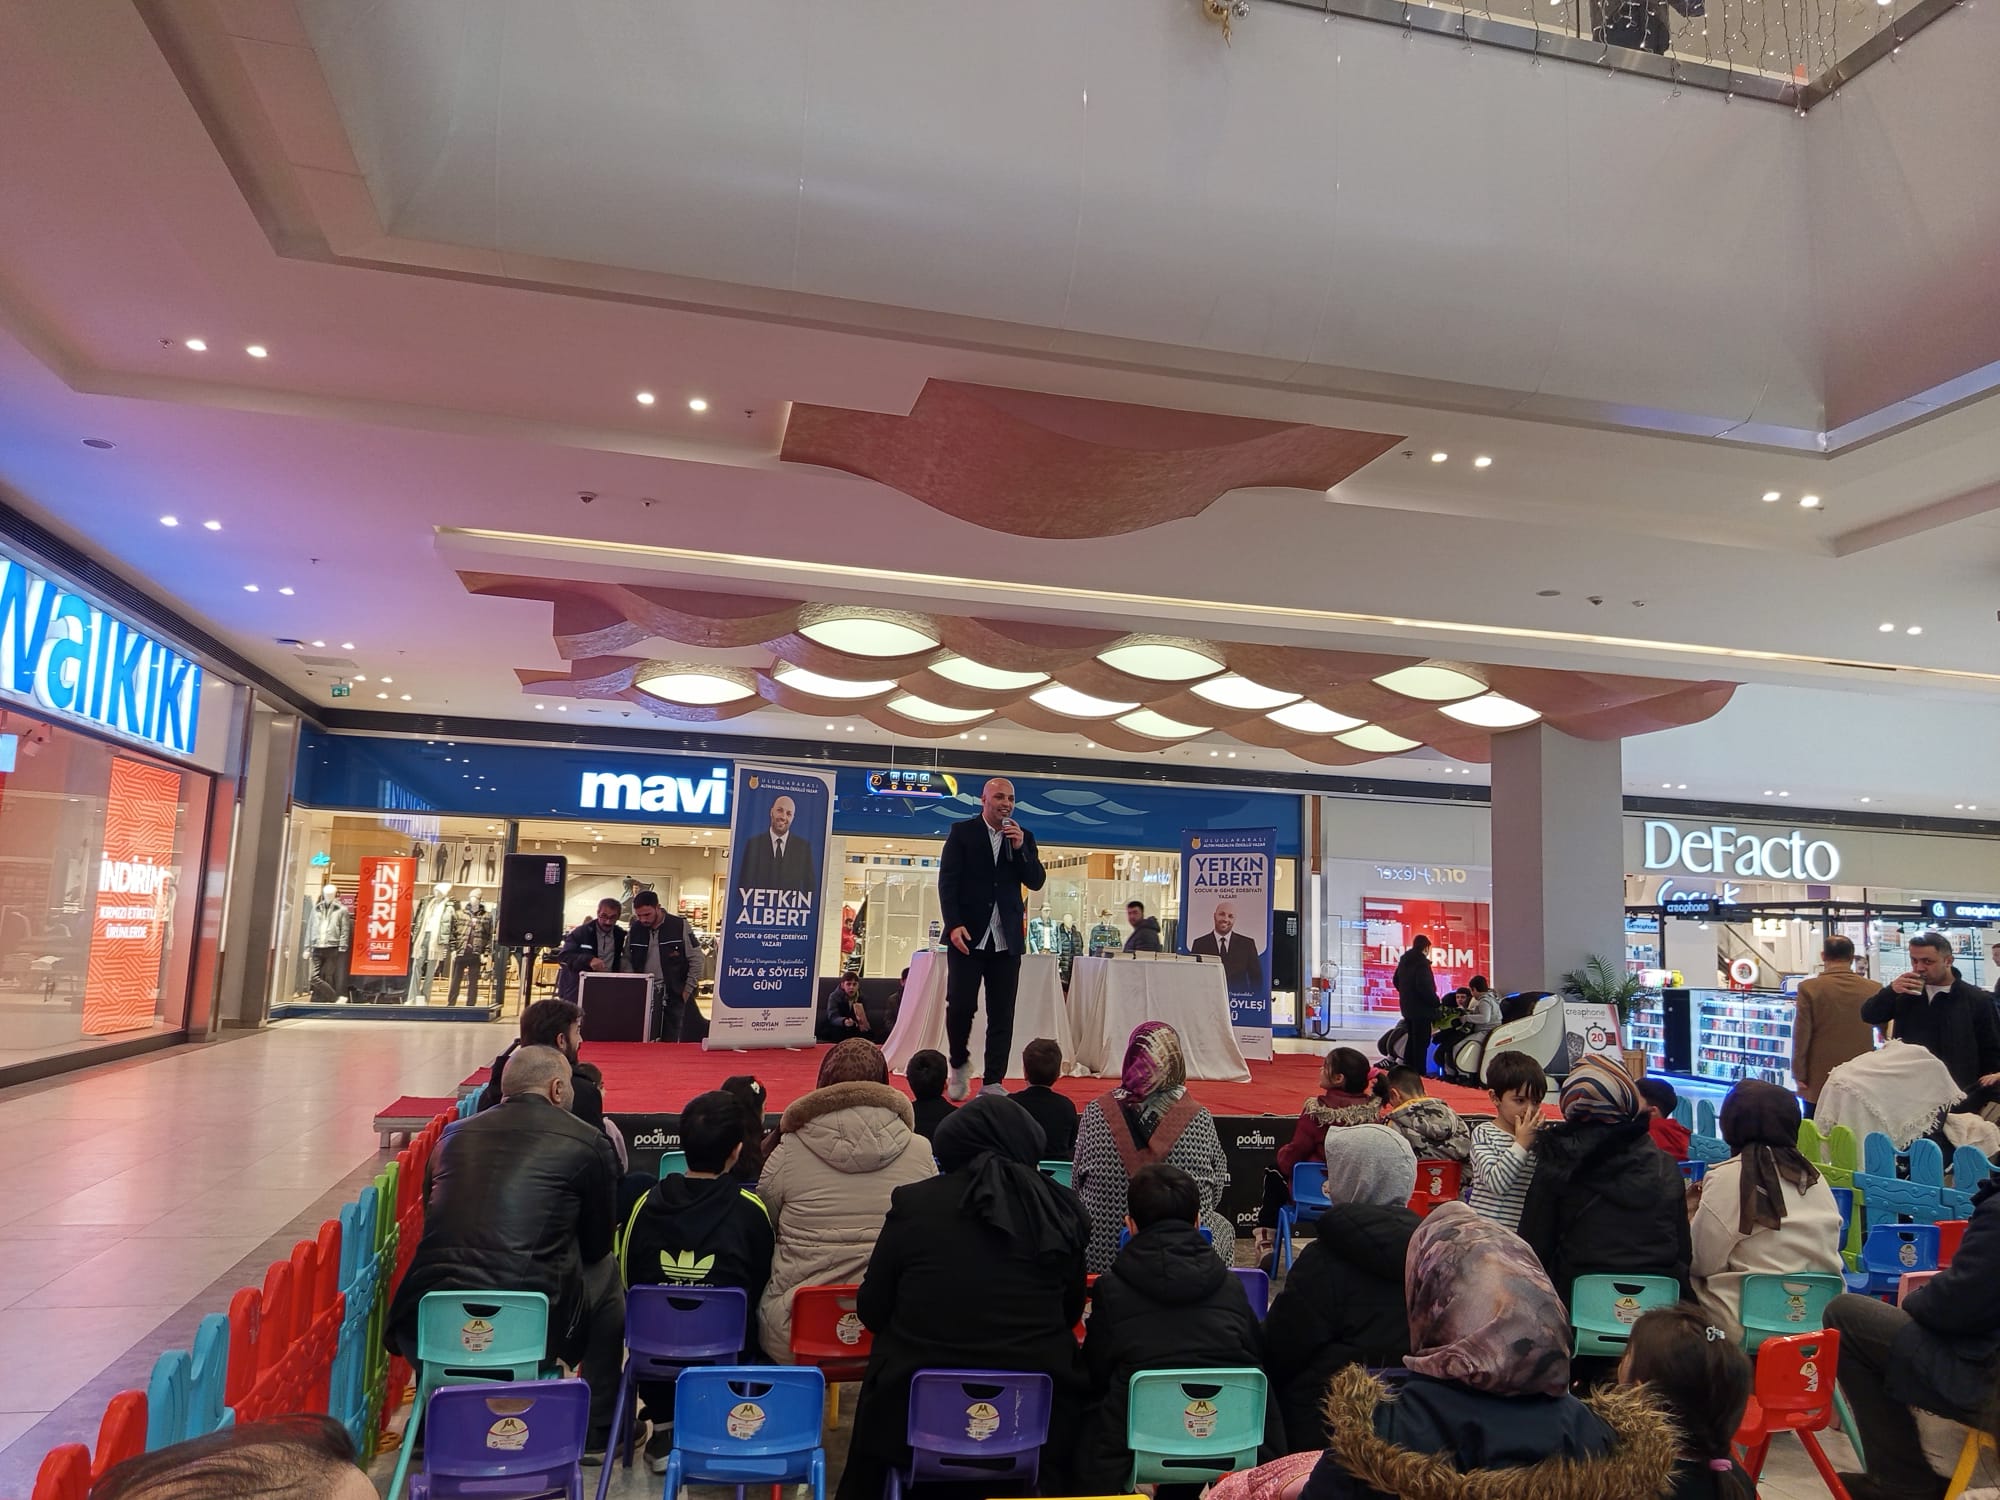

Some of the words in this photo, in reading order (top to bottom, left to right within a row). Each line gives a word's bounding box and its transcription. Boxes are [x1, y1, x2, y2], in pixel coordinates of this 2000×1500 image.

[580, 768, 727, 814] mavi
[1643, 820, 1840, 882] DeFacto
[1194, 873, 1263, 887] ALBERT
[736, 906, 811, 927] ALBERT
[369, 920, 395, 939] M
[735, 932, 758, 940] ÇOCUK
[763, 933, 779, 941] GENÇ
[781, 933, 808, 941] EDEBİYATI
[370, 942, 393, 950] SALE
[728, 965, 754, 977] İMZA
[757, 968, 766, 977] &
[769, 966, 808, 980] SÖYLEŞİ
[753, 980, 783, 991] GÜNÜ
[1229, 998, 1266, 1012] ÖYLEŞİ
[1565, 1008, 1606, 1018] creaphone
[1591, 1033, 1604, 1042] 20
[634, 1129, 681, 1147] podium
[1236, 1130, 1276, 1146] podium
